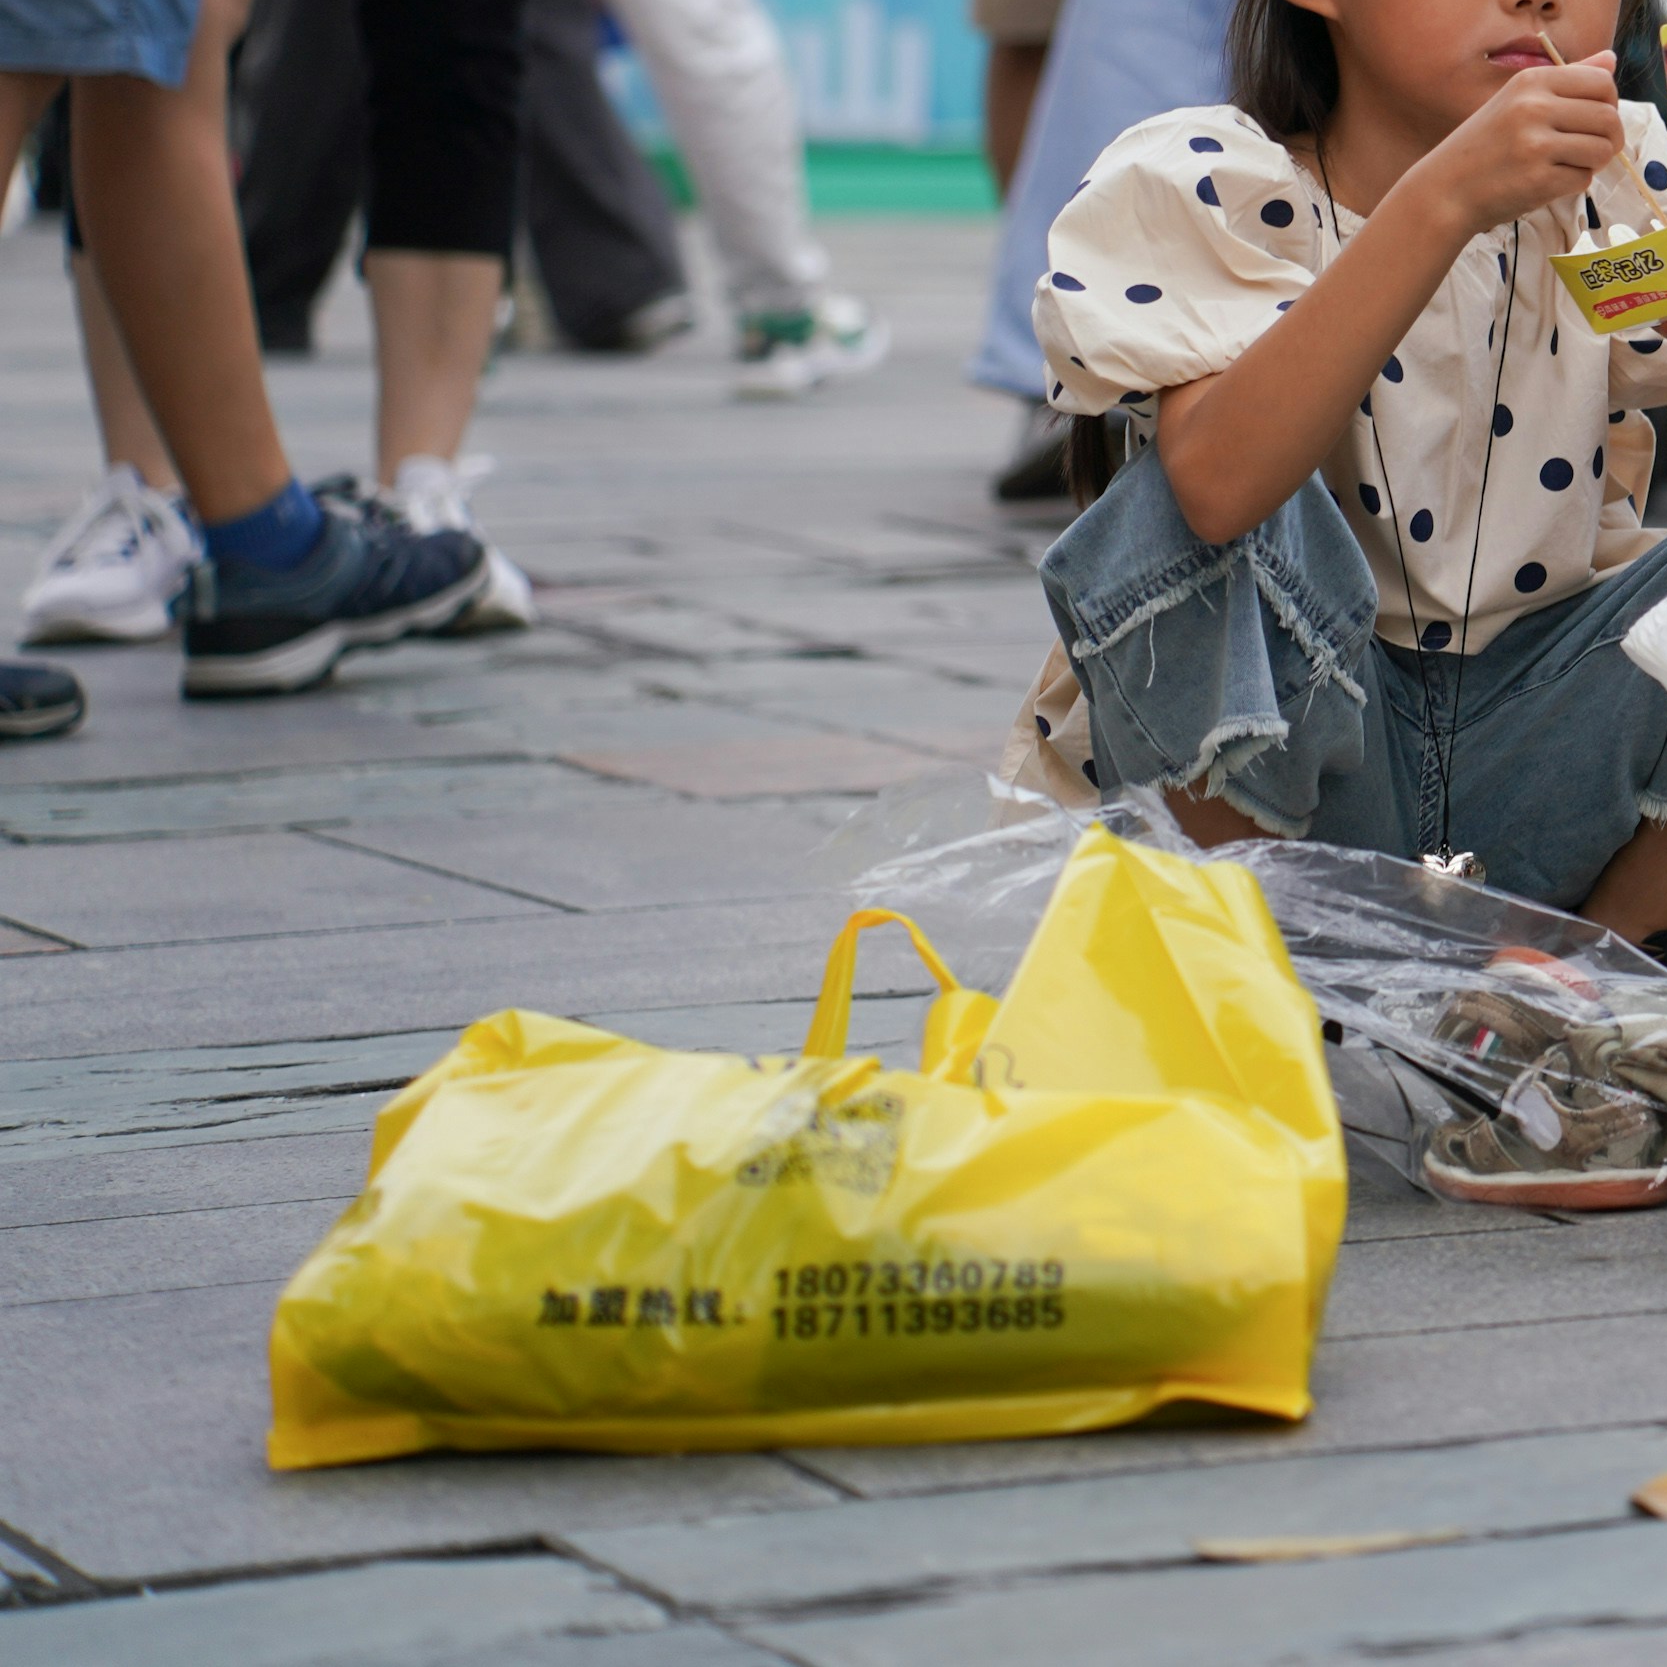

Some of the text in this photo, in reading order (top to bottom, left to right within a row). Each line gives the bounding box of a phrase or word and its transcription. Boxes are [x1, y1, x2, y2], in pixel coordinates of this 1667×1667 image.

[1579, 249, 1664, 290] 口袋记忆
[775, 1259, 1065, 1299] 18073360789
[771, 1295, 1066, 1340] 18711393685
